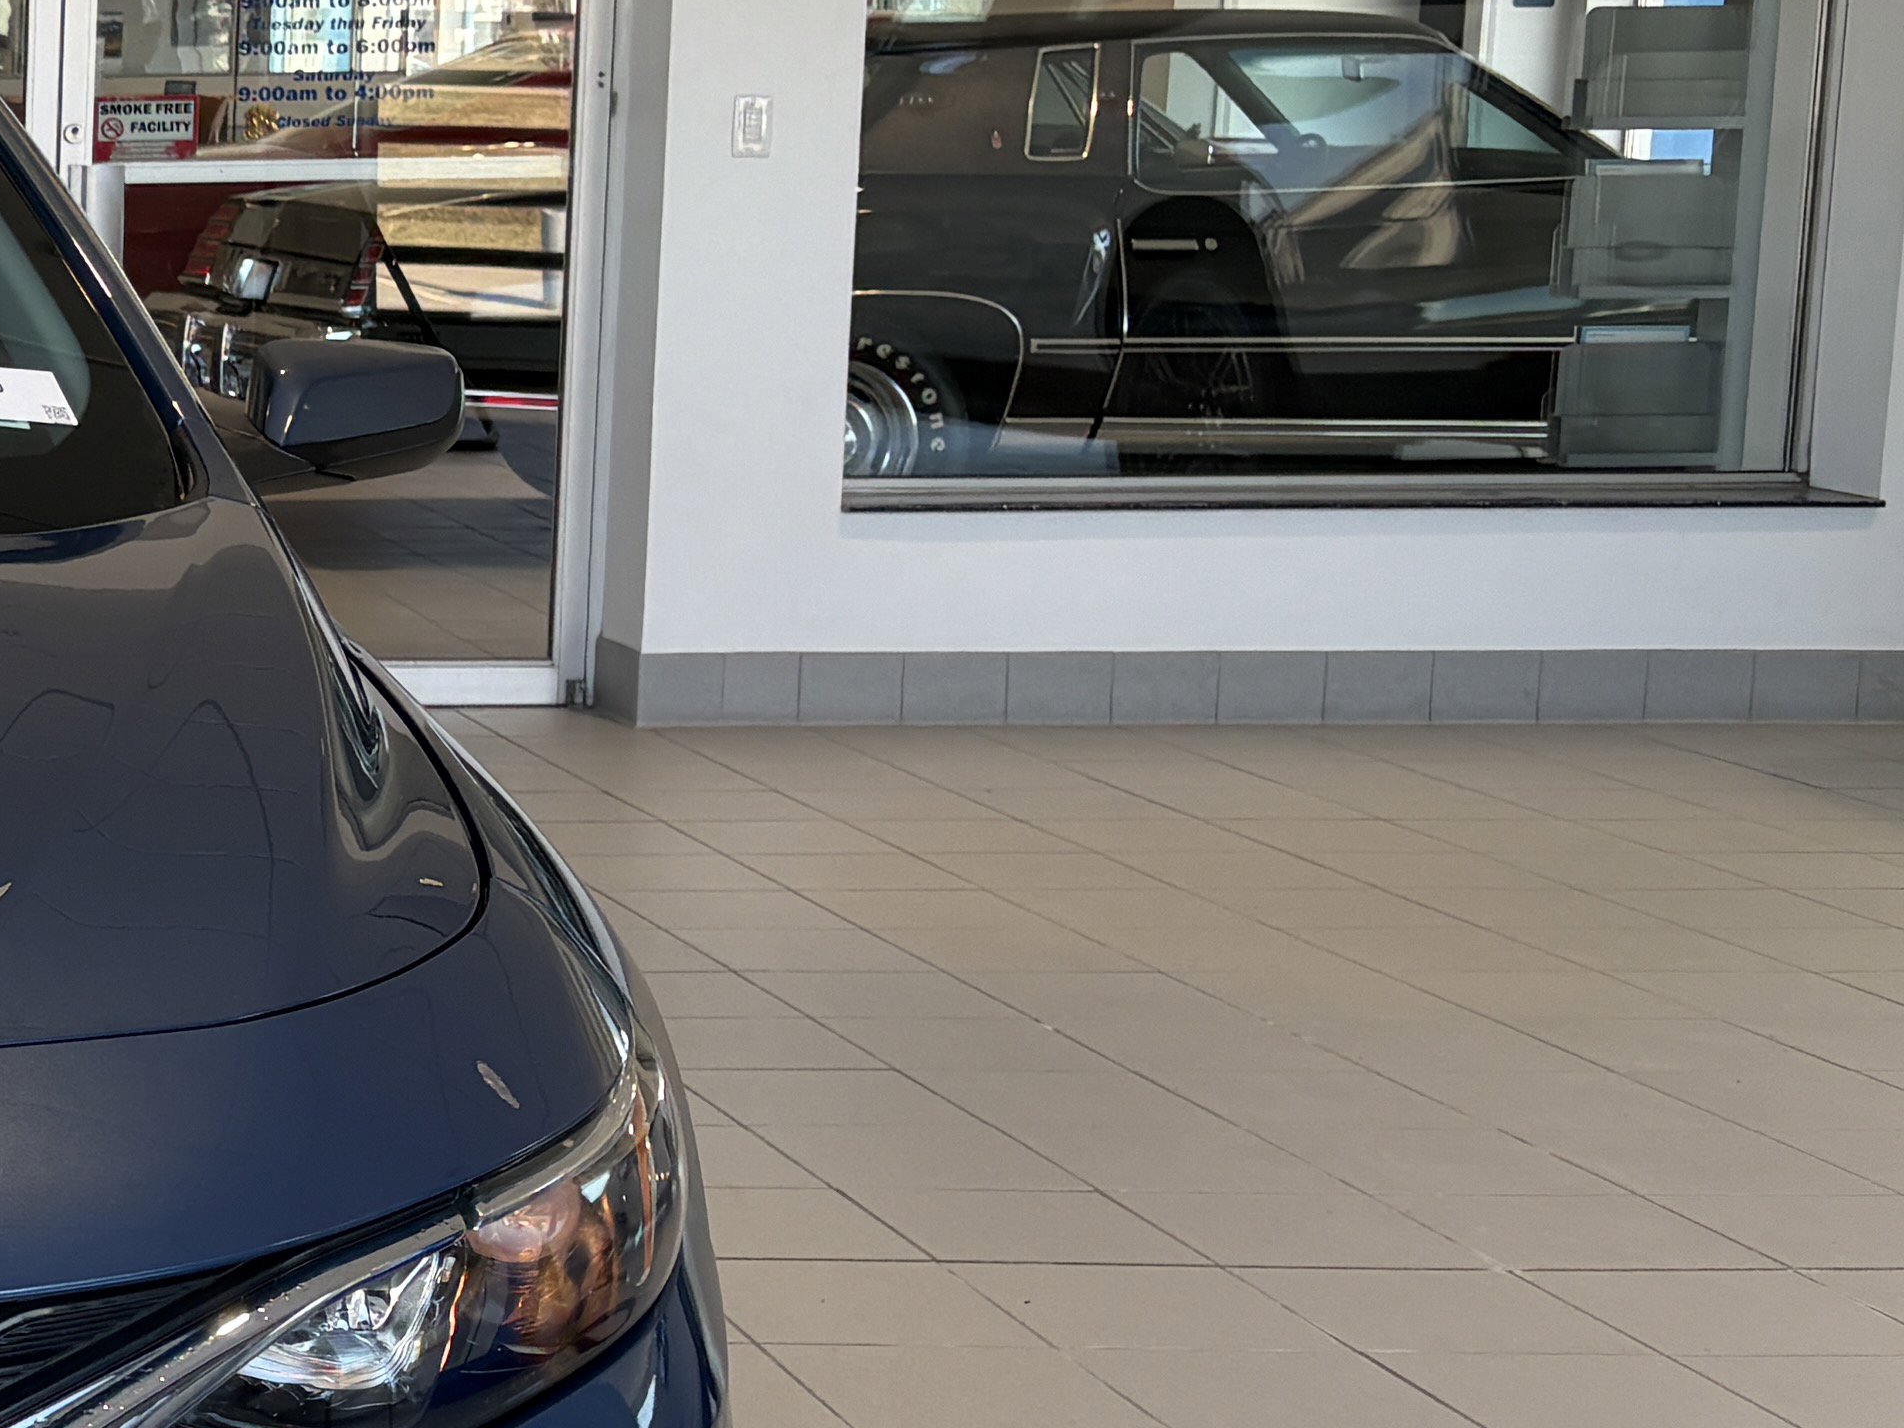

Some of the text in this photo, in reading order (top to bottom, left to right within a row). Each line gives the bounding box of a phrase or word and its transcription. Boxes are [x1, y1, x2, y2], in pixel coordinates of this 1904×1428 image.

[254, 15, 427, 33] Tuesday thru Friday
[238, 38, 436, 57] 9:00am to 6:00pm
[294, 69, 376, 84] Saturday
[238, 84, 435, 103] 9:00am to 4:00pm
[100, 103, 193, 115] SMOKE FREE
[130, 121, 191, 133] FACILITY
[857, 336, 946, 453] restone
